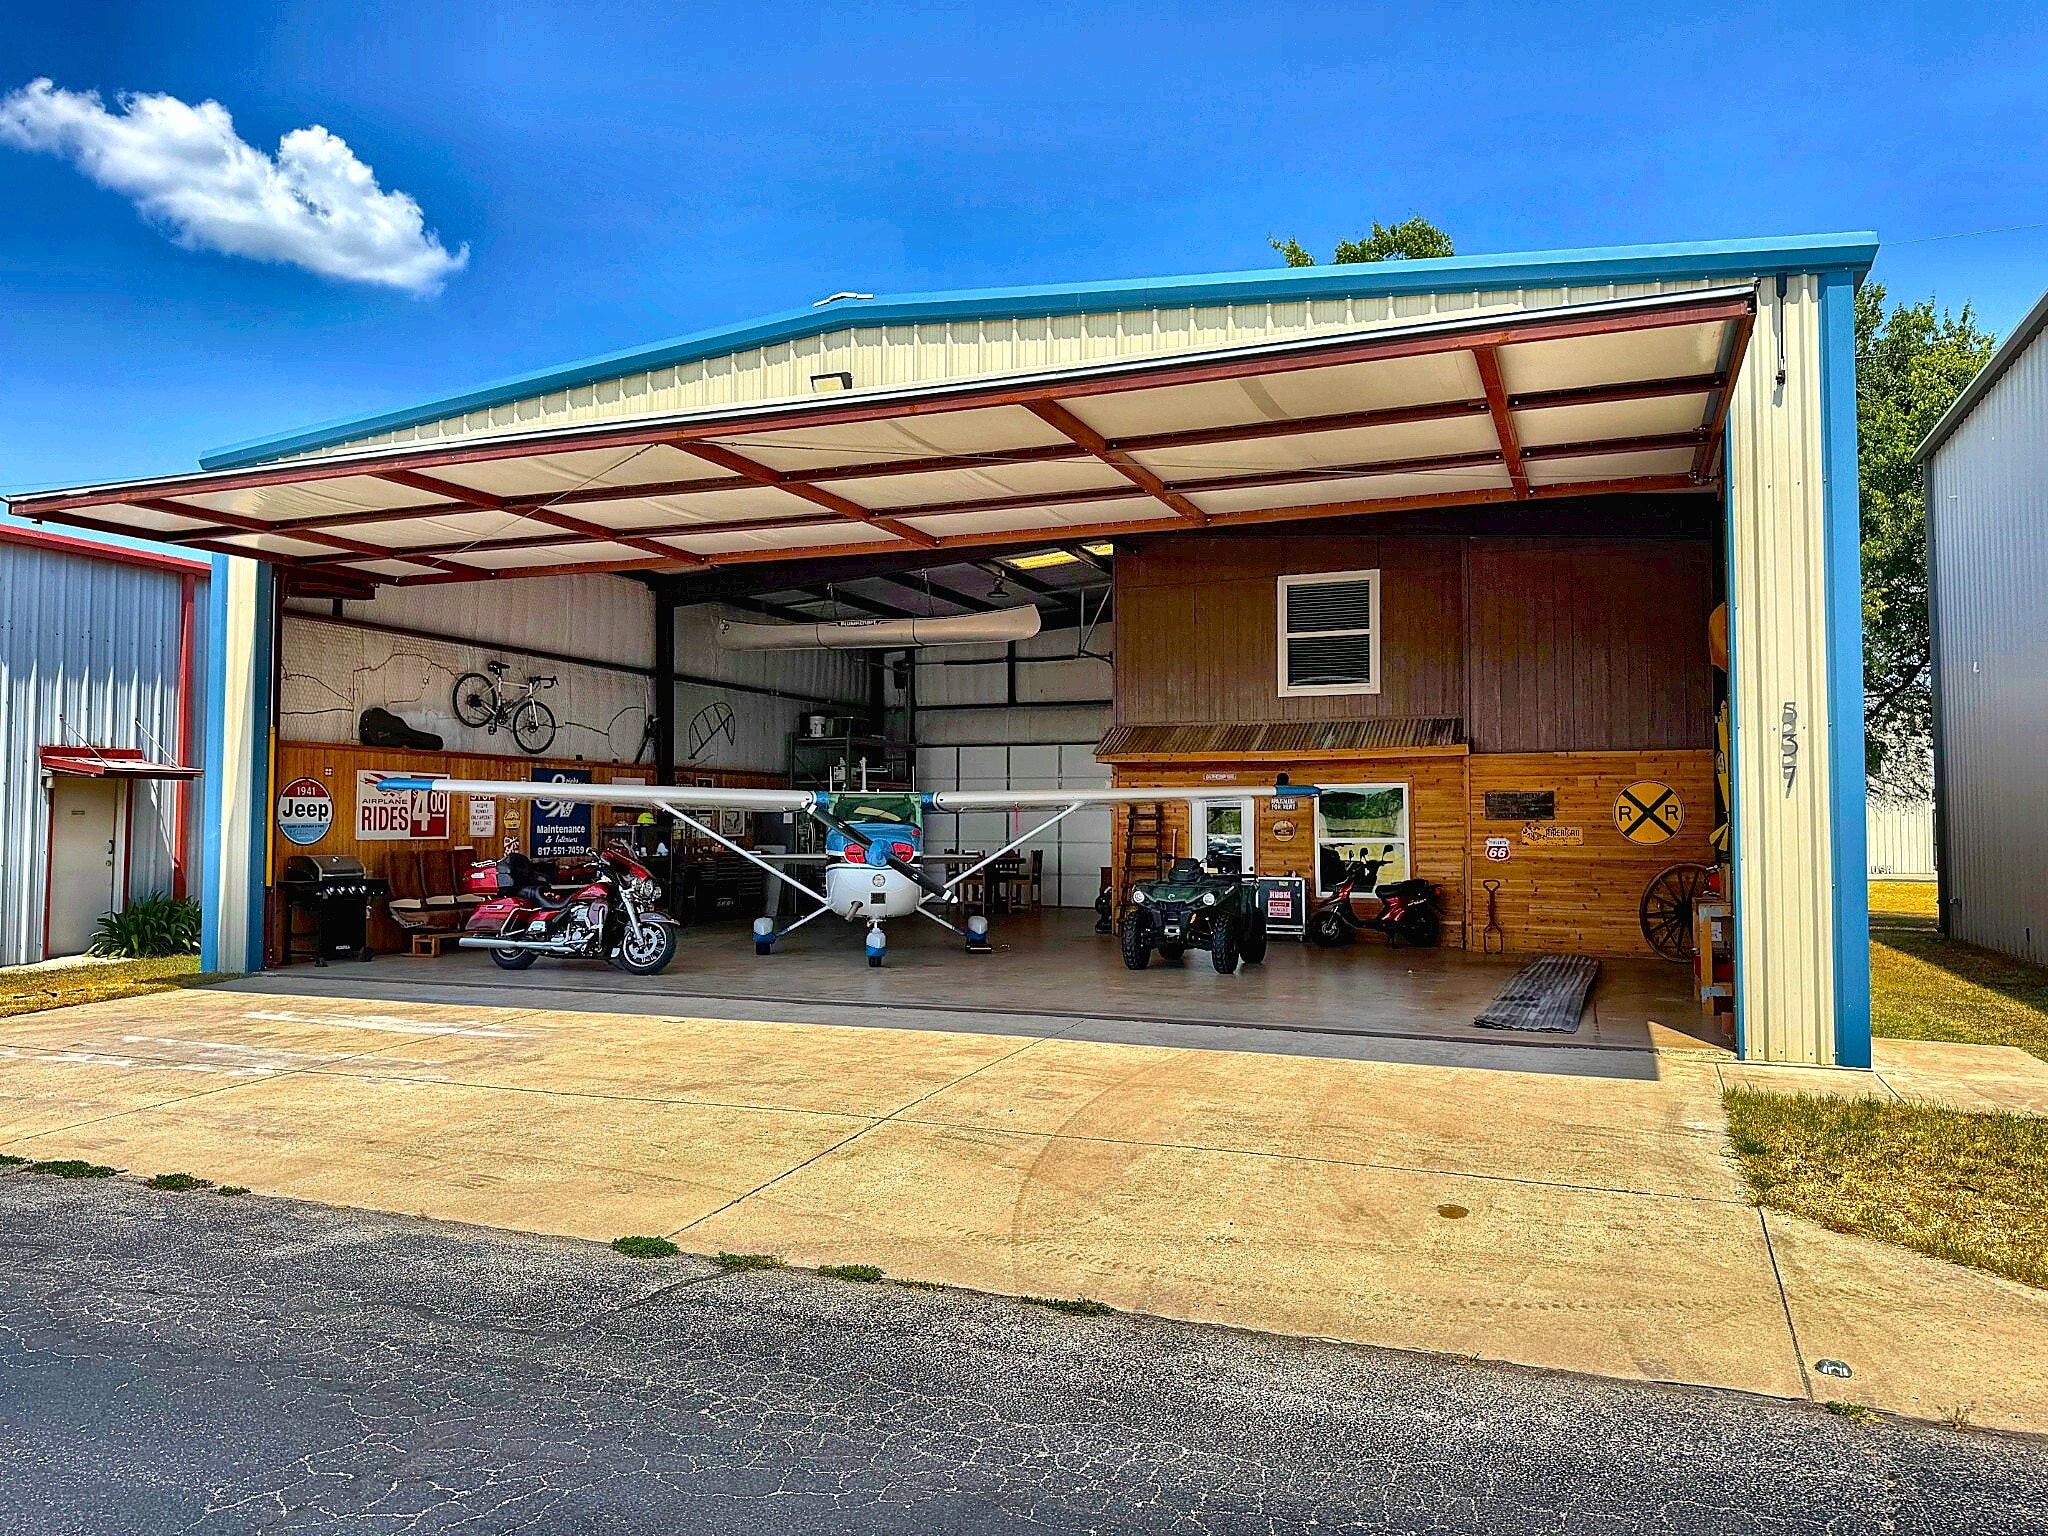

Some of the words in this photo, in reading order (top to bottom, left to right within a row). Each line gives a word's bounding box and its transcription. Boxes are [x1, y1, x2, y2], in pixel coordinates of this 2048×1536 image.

[297, 786, 316, 796] 1941
[282, 798, 328, 821] Jeep
[1618, 805, 1632, 821] R
[1664, 804, 1679, 820] R
[361, 806, 409, 831] RIDES
[536, 825, 586, 834] Maintenance
[545, 835, 552, 844] &
[537, 845, 585, 856] 817-551-7459
[1489, 847, 1507, 857] 66
